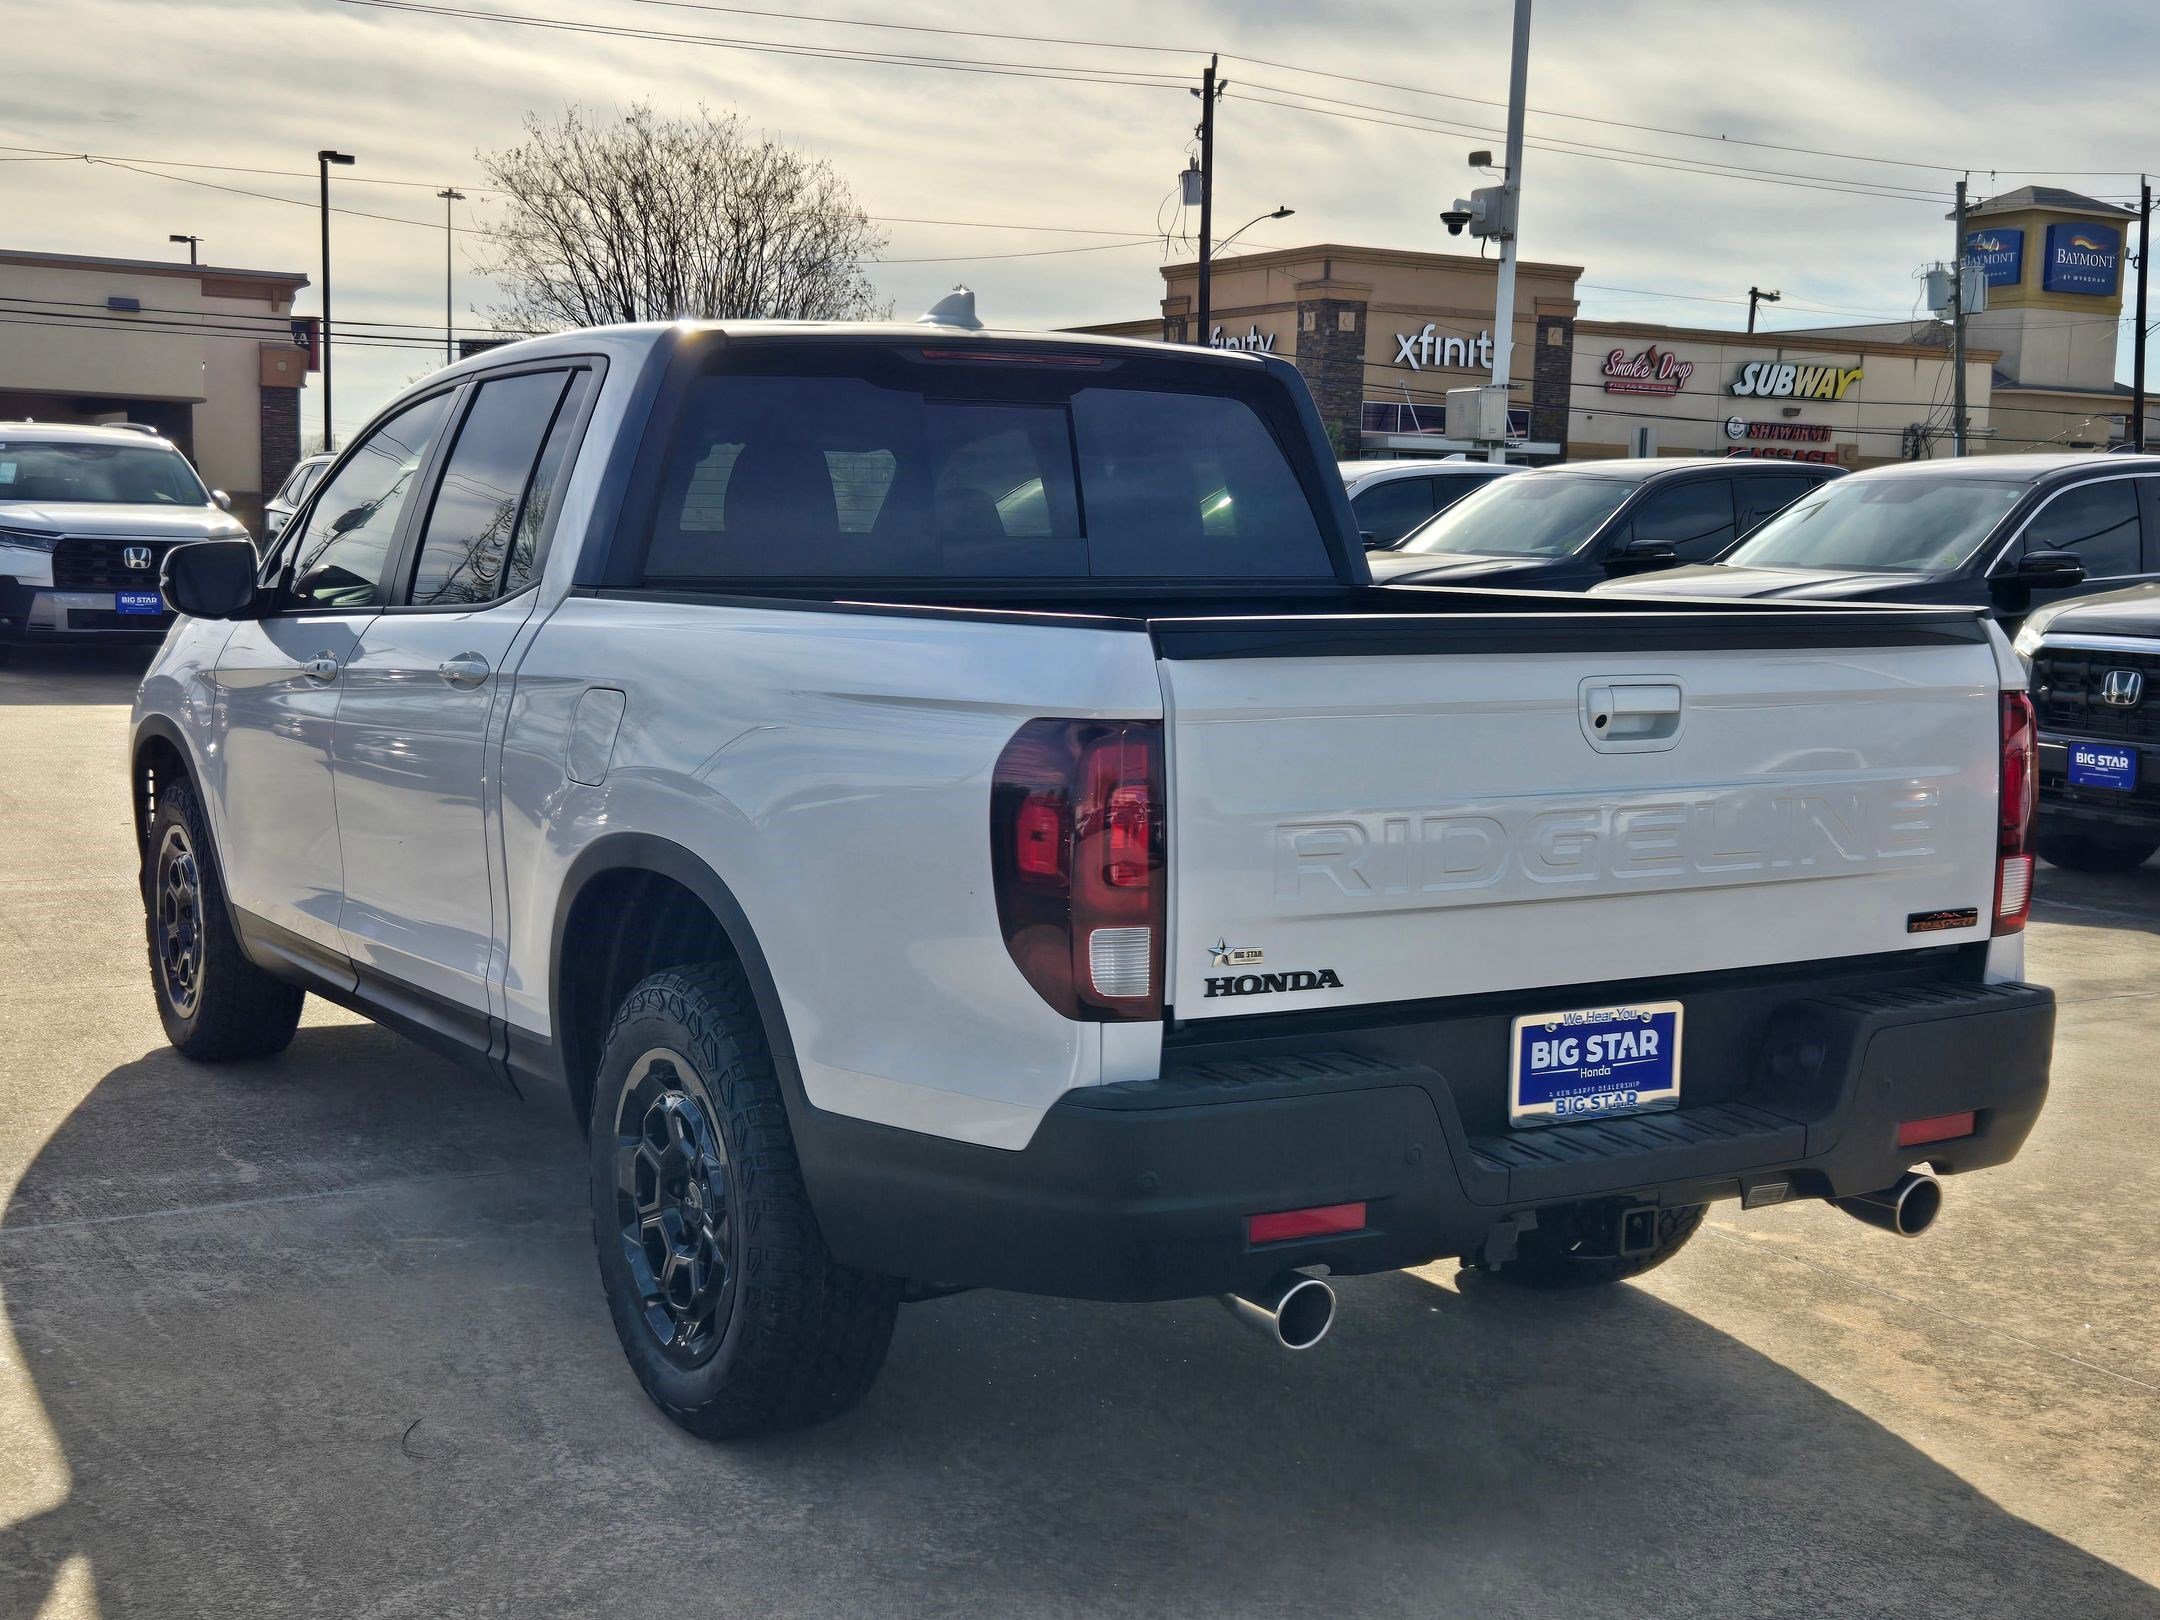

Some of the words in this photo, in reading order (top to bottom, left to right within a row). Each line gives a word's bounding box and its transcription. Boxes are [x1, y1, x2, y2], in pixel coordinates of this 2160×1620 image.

[2057, 248, 2115, 268] BAYMONT
[1209, 325, 1275, 352] finity
[1393, 323, 1515, 370] xfinit
[1602, 348, 1651, 378] Smoke
[1656, 352, 1693, 389] Drop
[1732, 363, 1863, 400] SUBWAY
[2075, 752, 2095, 765] BIG
[2097, 755, 2128, 769] STAR
[1273, 784, 1941, 902] RIDGELINE
[1203, 968, 1344, 998] HONDA
[1563, 1013, 1583, 1027] We
[1586, 1009, 1613, 1024] Hear
[1616, 1008, 1638, 1021] You
[1531, 1038, 1580, 1070] BIG
[1586, 1029, 1659, 1063] STAR
[1580, 1065, 1611, 1079] Honda
[1598, 1080, 1640, 1092] DEALERSHIP
[1554, 1095, 1585, 1115] BIG
[1589, 1089, 1639, 1111] STAR
